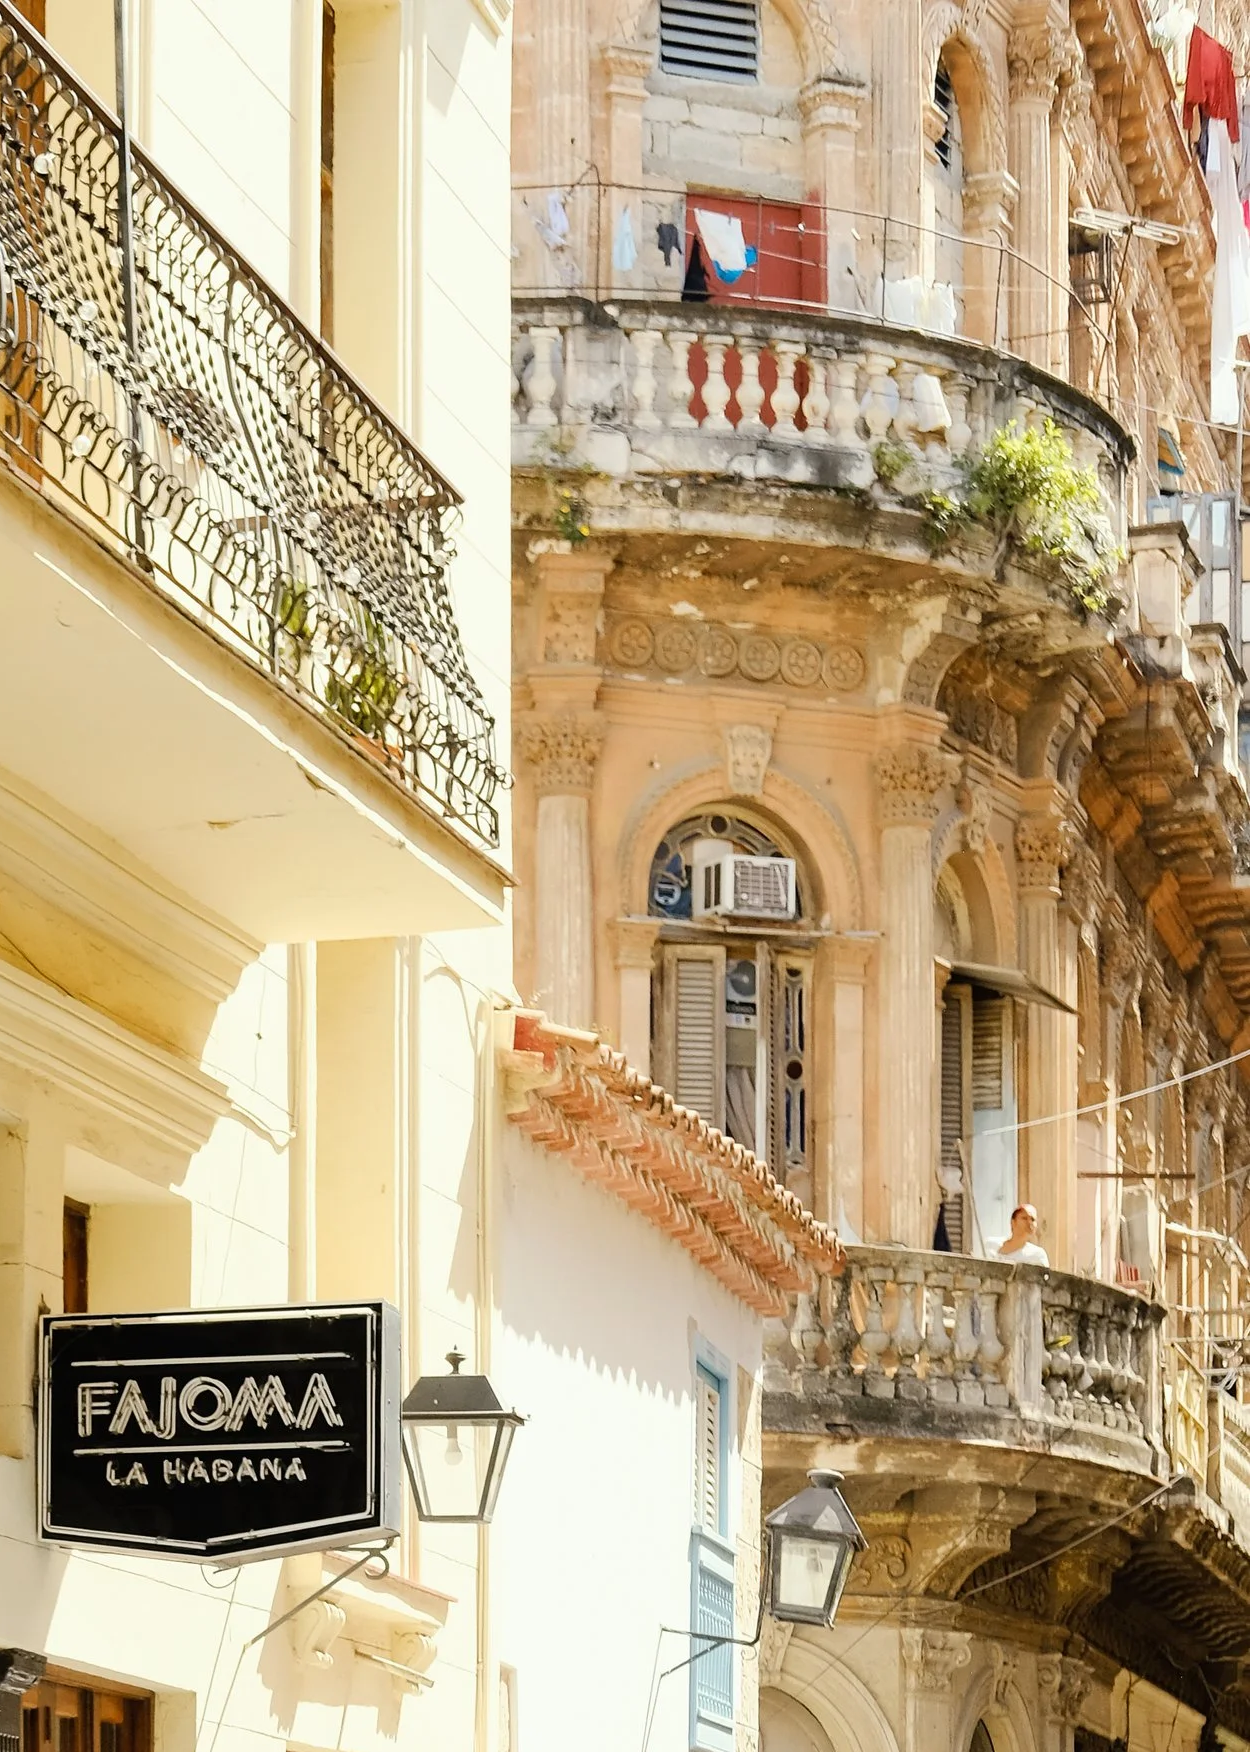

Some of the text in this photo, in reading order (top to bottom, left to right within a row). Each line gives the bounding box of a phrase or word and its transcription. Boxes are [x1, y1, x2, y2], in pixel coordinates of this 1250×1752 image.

[77, 1372, 344, 1440] FAJOMA
[106, 1456, 307, 1486] LA HABANA
